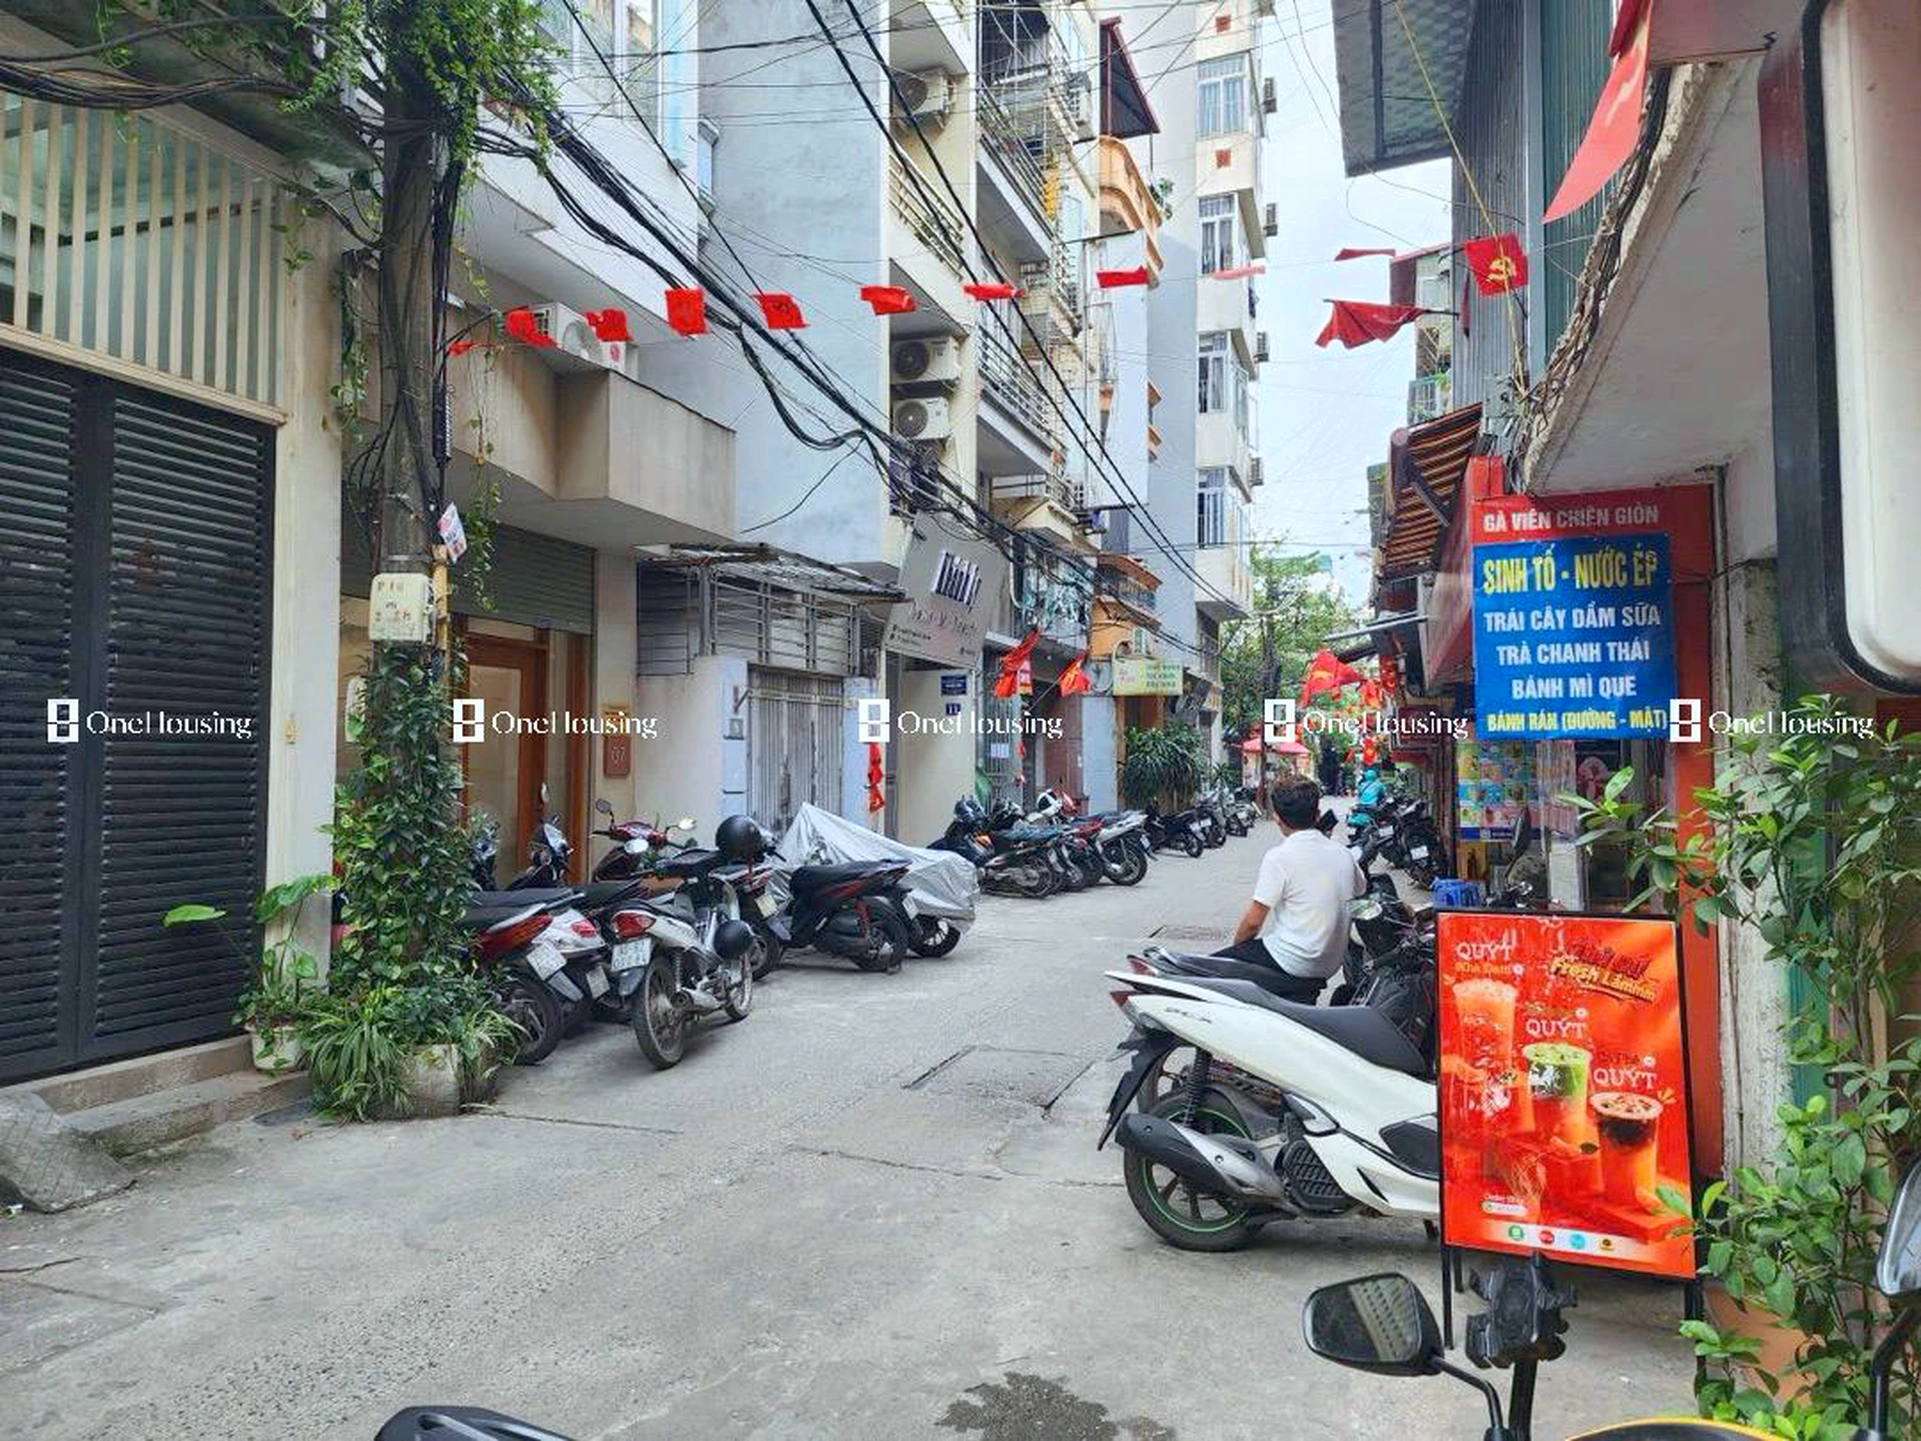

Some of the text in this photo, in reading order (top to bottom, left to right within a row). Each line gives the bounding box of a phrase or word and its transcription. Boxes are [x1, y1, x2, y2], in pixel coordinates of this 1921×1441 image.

[1483, 511, 1508, 532] GÀ
[1512, 508, 1551, 530] VIÊN
[1483, 556, 1528, 594] SINH
[1532, 543, 1556, 591] TỐ
[1574, 545, 1626, 589] NƯỚC
[1484, 606, 1525, 632] TRÁI
[1530, 605, 1566, 630] CÂY
[1621, 602, 1661, 626] SỮA
[1496, 638, 1650, 666] TRÀ CHANH THÁI
[1512, 673, 1637, 699] BÁNH MÌ QUE
